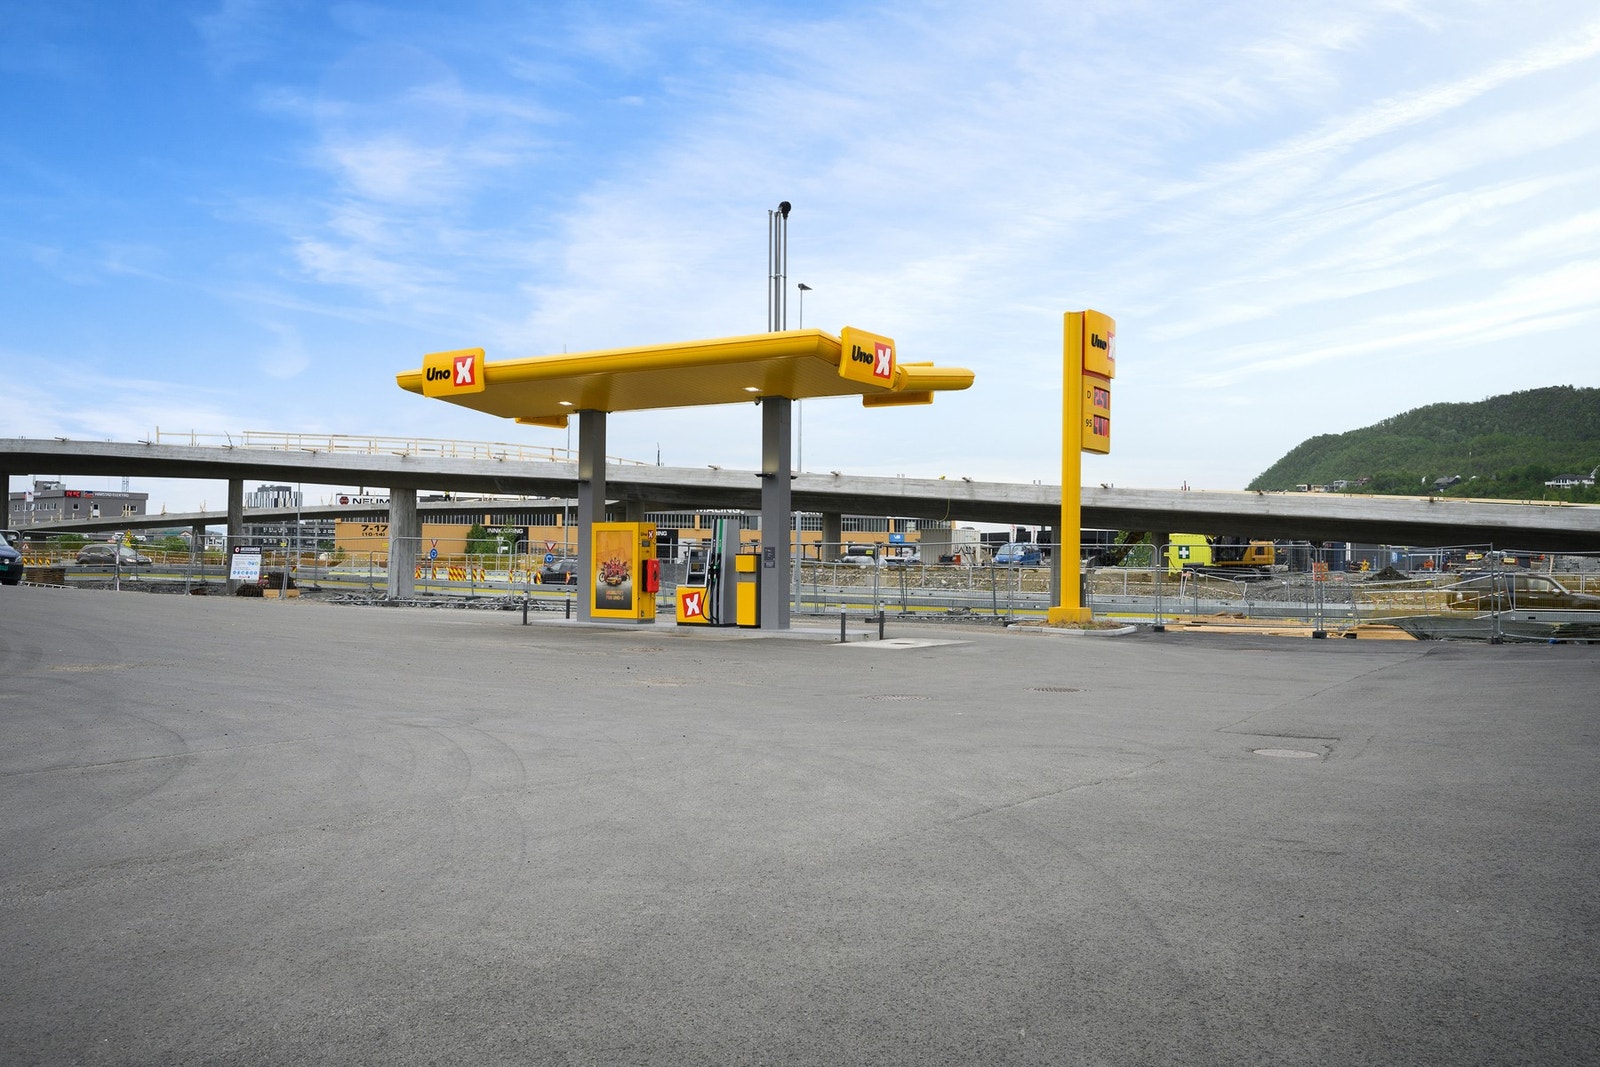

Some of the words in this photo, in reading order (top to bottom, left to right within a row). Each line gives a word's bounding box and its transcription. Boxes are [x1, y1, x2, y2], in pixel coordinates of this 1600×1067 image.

[1091, 333, 1107, 350] Uno
[852, 344, 874, 365] Uno
[875, 347, 892, 376] X
[426, 367, 451, 381] Uno
[456, 357, 473, 384] X
[1086, 390, 1092, 399] D
[1085, 418, 1093, 427] 95
[361, 524, 389, 532] 7-17
[685, 593, 701, 616] X
